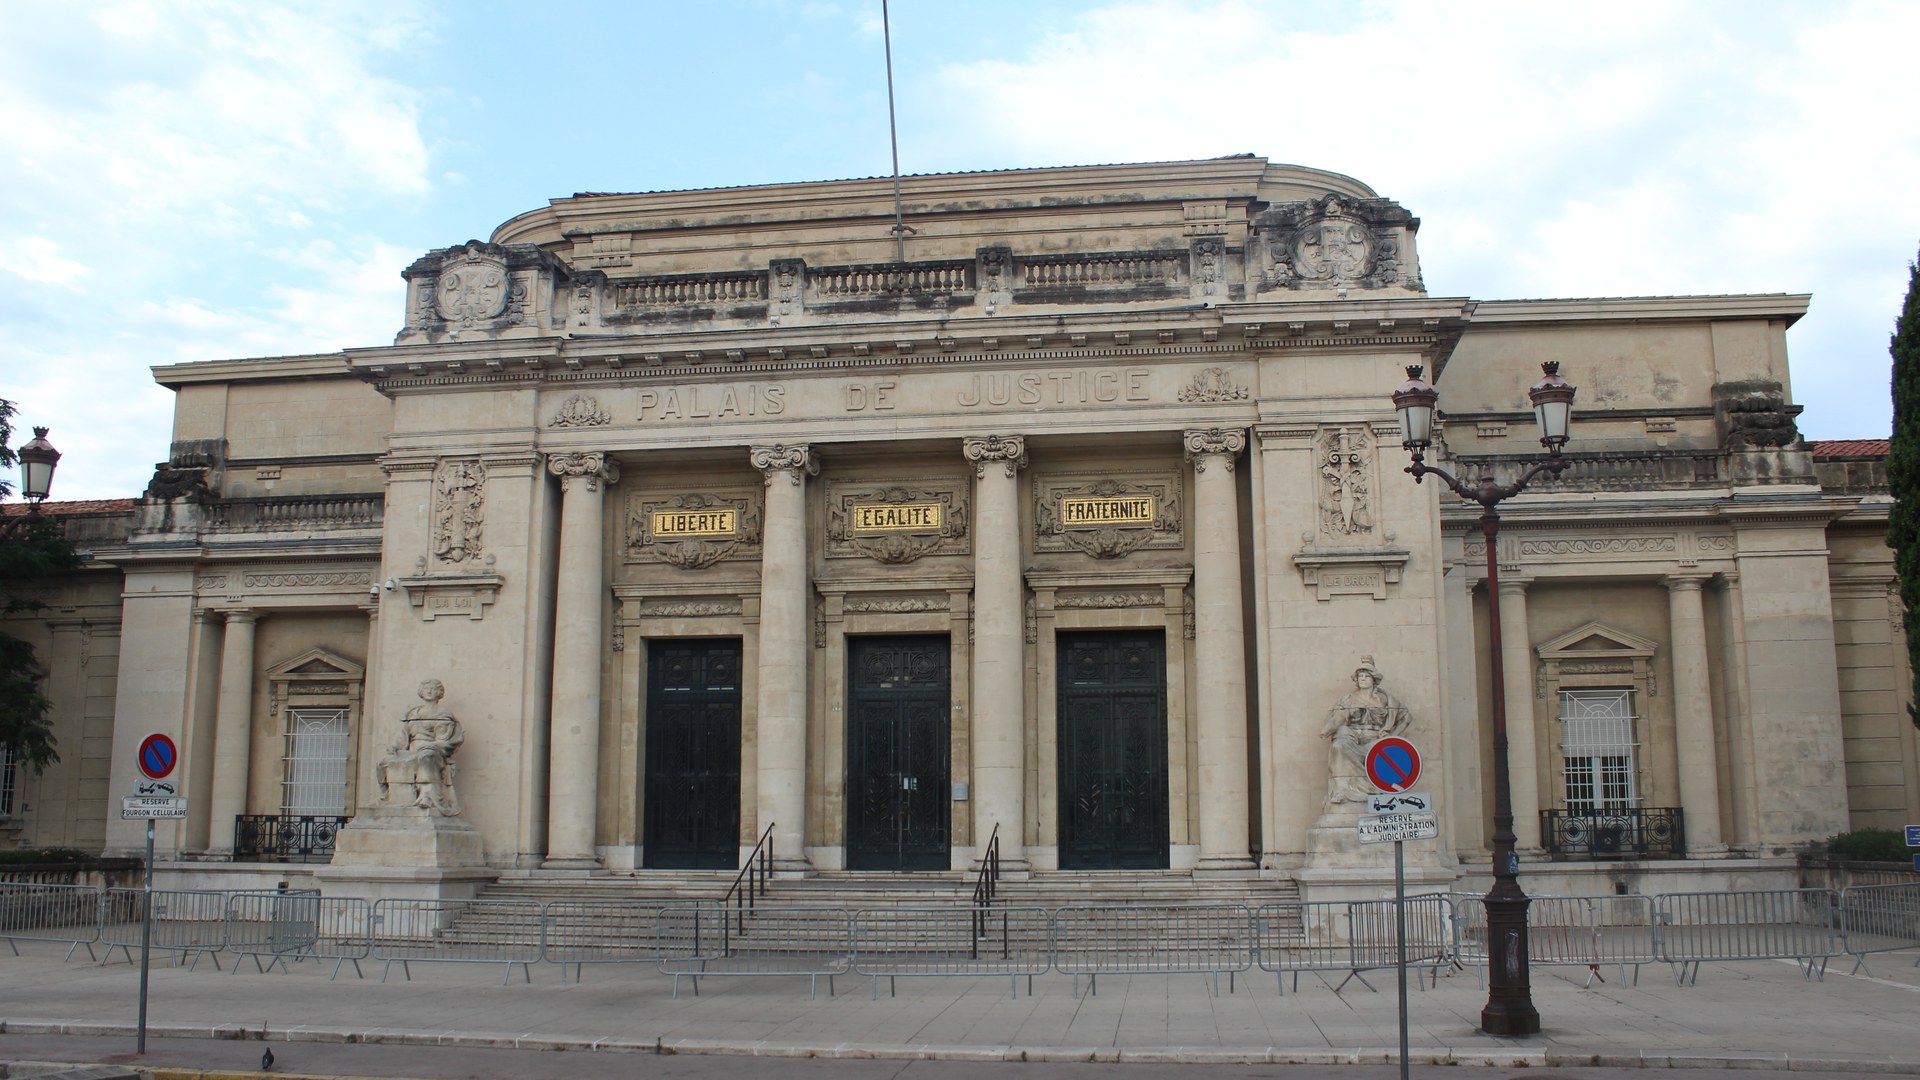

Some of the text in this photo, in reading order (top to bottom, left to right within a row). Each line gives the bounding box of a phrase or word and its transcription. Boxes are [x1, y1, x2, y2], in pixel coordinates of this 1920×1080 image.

[636, 368, 1150, 420] PALAIS DE JUSTICE
[661, 512, 727, 532] LIBERTÉ
[863, 506, 931, 526] ÉGALITÉ
[1326, 575, 1377, 587] LE DROIT
[434, 597, 472, 609] LA LOI
[122, 809, 187, 817] FOURGON CELLULAIRE
[1366, 820, 1435, 833] L'ADMINISTRATION
[1378, 830, 1419, 841] JUDICIAIRE
